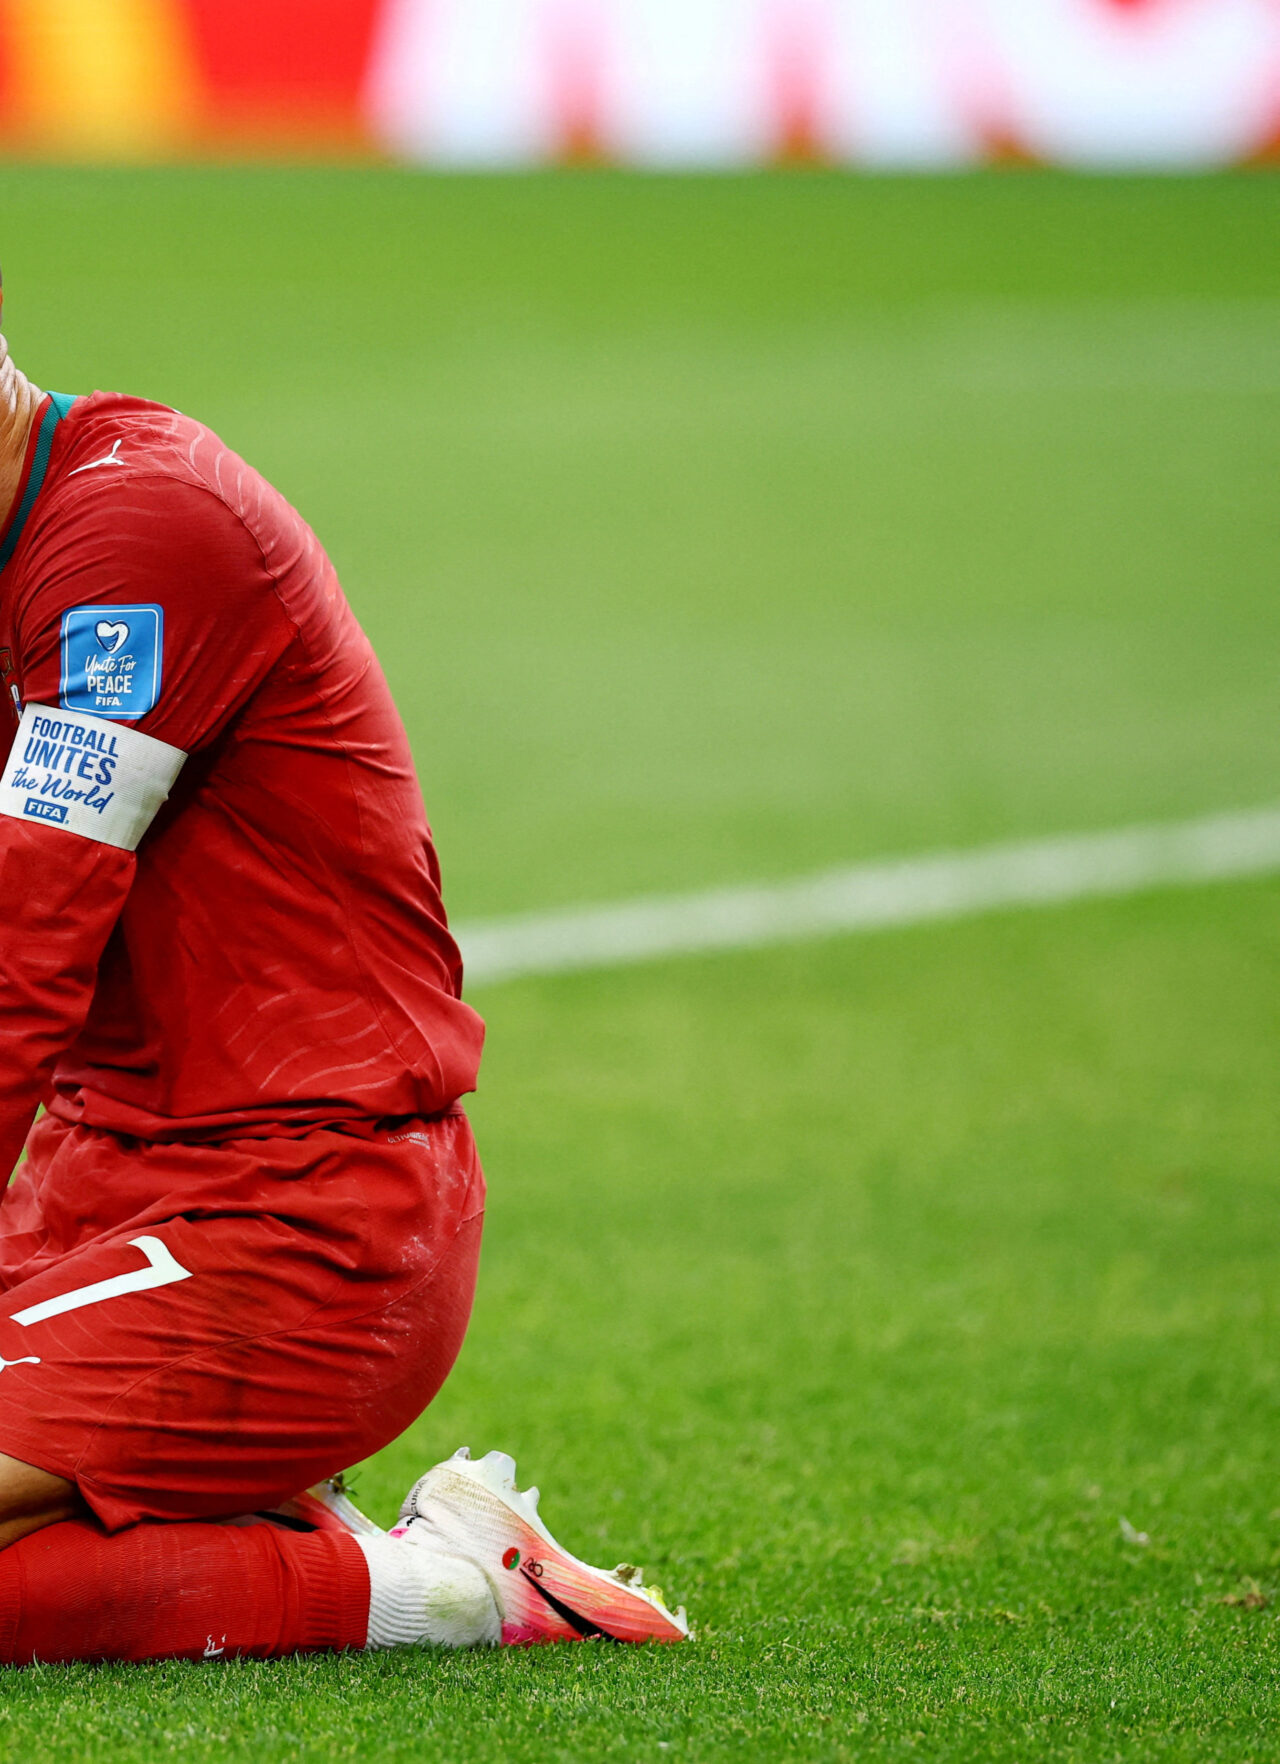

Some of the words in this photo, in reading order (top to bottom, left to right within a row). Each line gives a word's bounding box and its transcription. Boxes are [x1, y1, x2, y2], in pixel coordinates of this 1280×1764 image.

[85, 654, 117, 675] Unite
[118, 654, 137, 674] For
[87, 675, 133, 694] PEACE
[95, 696, 120, 706] FIFA
[31, 716, 119, 758] FOOTBALL
[23, 737, 116, 786] UNITES
[11, 767, 39, 790] the
[40, 773, 115, 814] World
[26, 800, 64, 821] FIFA
[9, 1235, 194, 1327] 7
